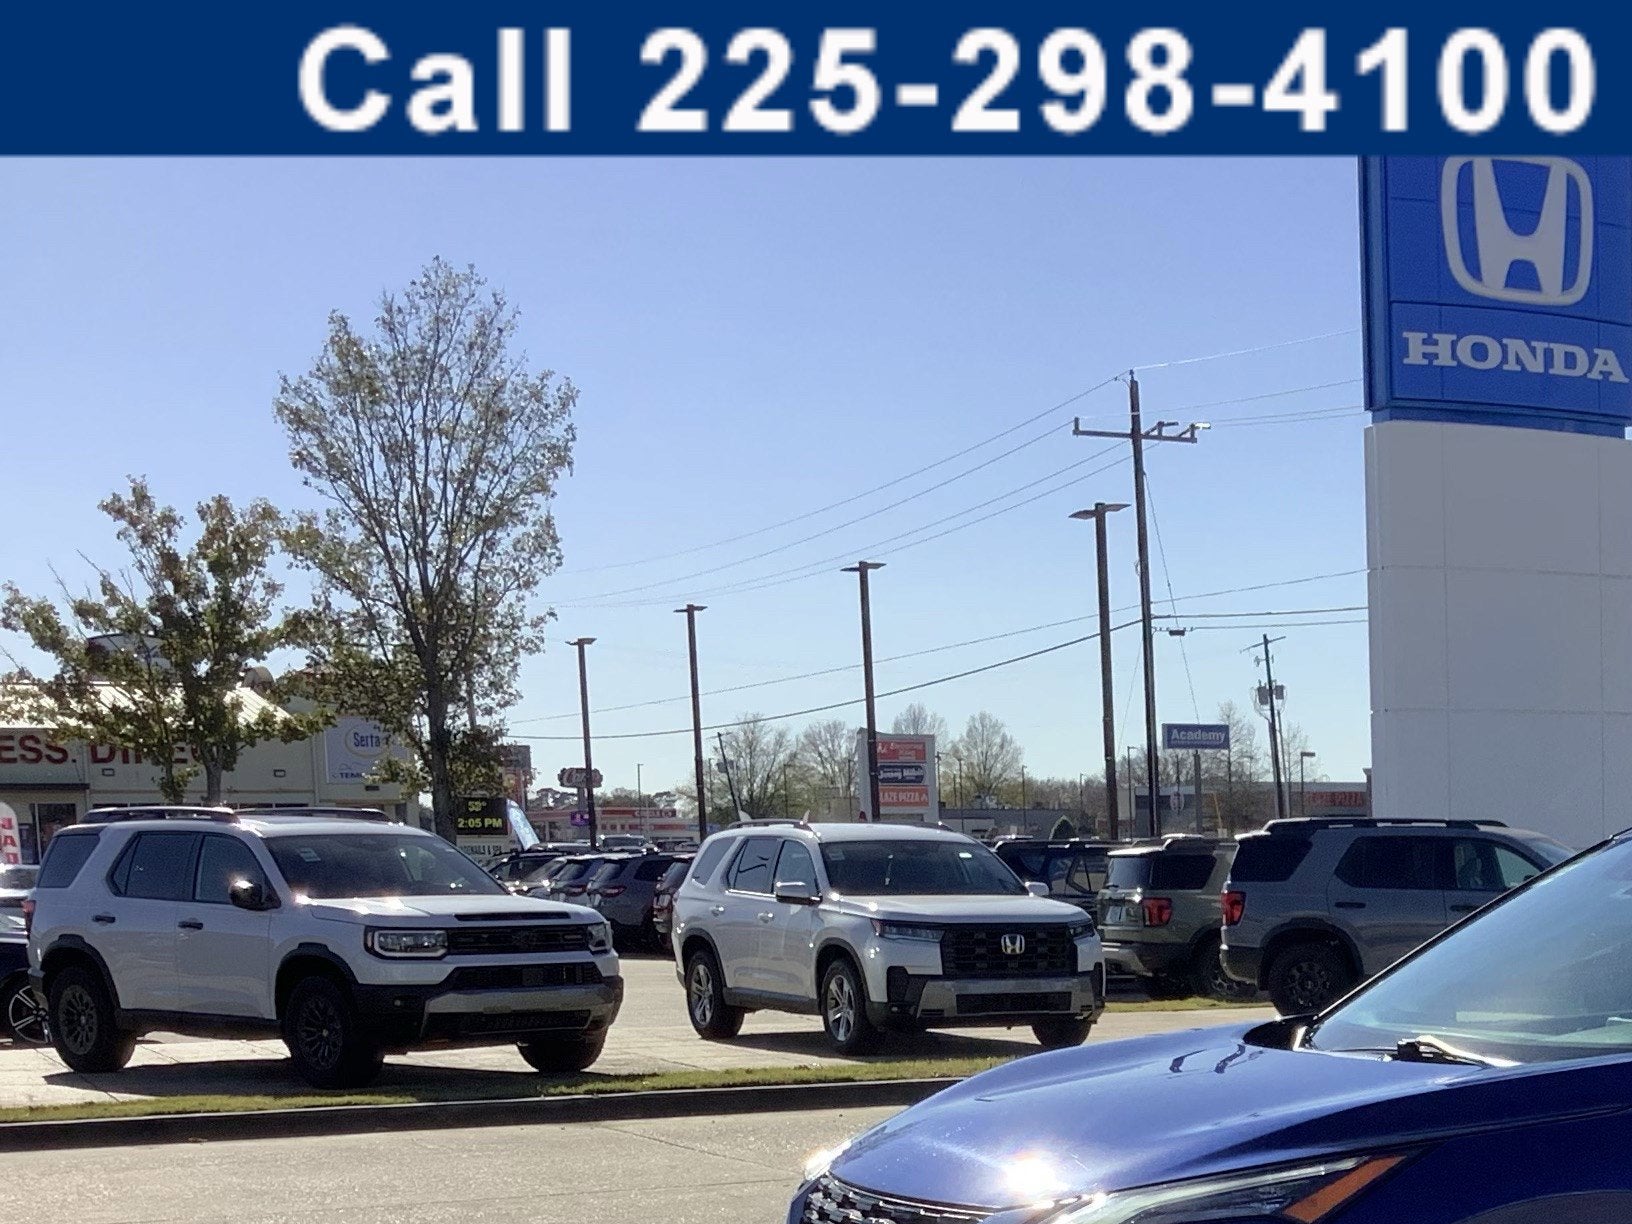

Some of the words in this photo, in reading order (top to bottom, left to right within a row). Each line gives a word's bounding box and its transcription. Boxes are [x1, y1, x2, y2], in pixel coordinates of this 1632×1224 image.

[1402, 331, 1630, 383] HONDA
[353, 731, 381, 748] Serta
[1171, 729, 1226, 744] Academy
[457, 817, 482, 829] 2:05
[484, 817, 503, 829] PM
